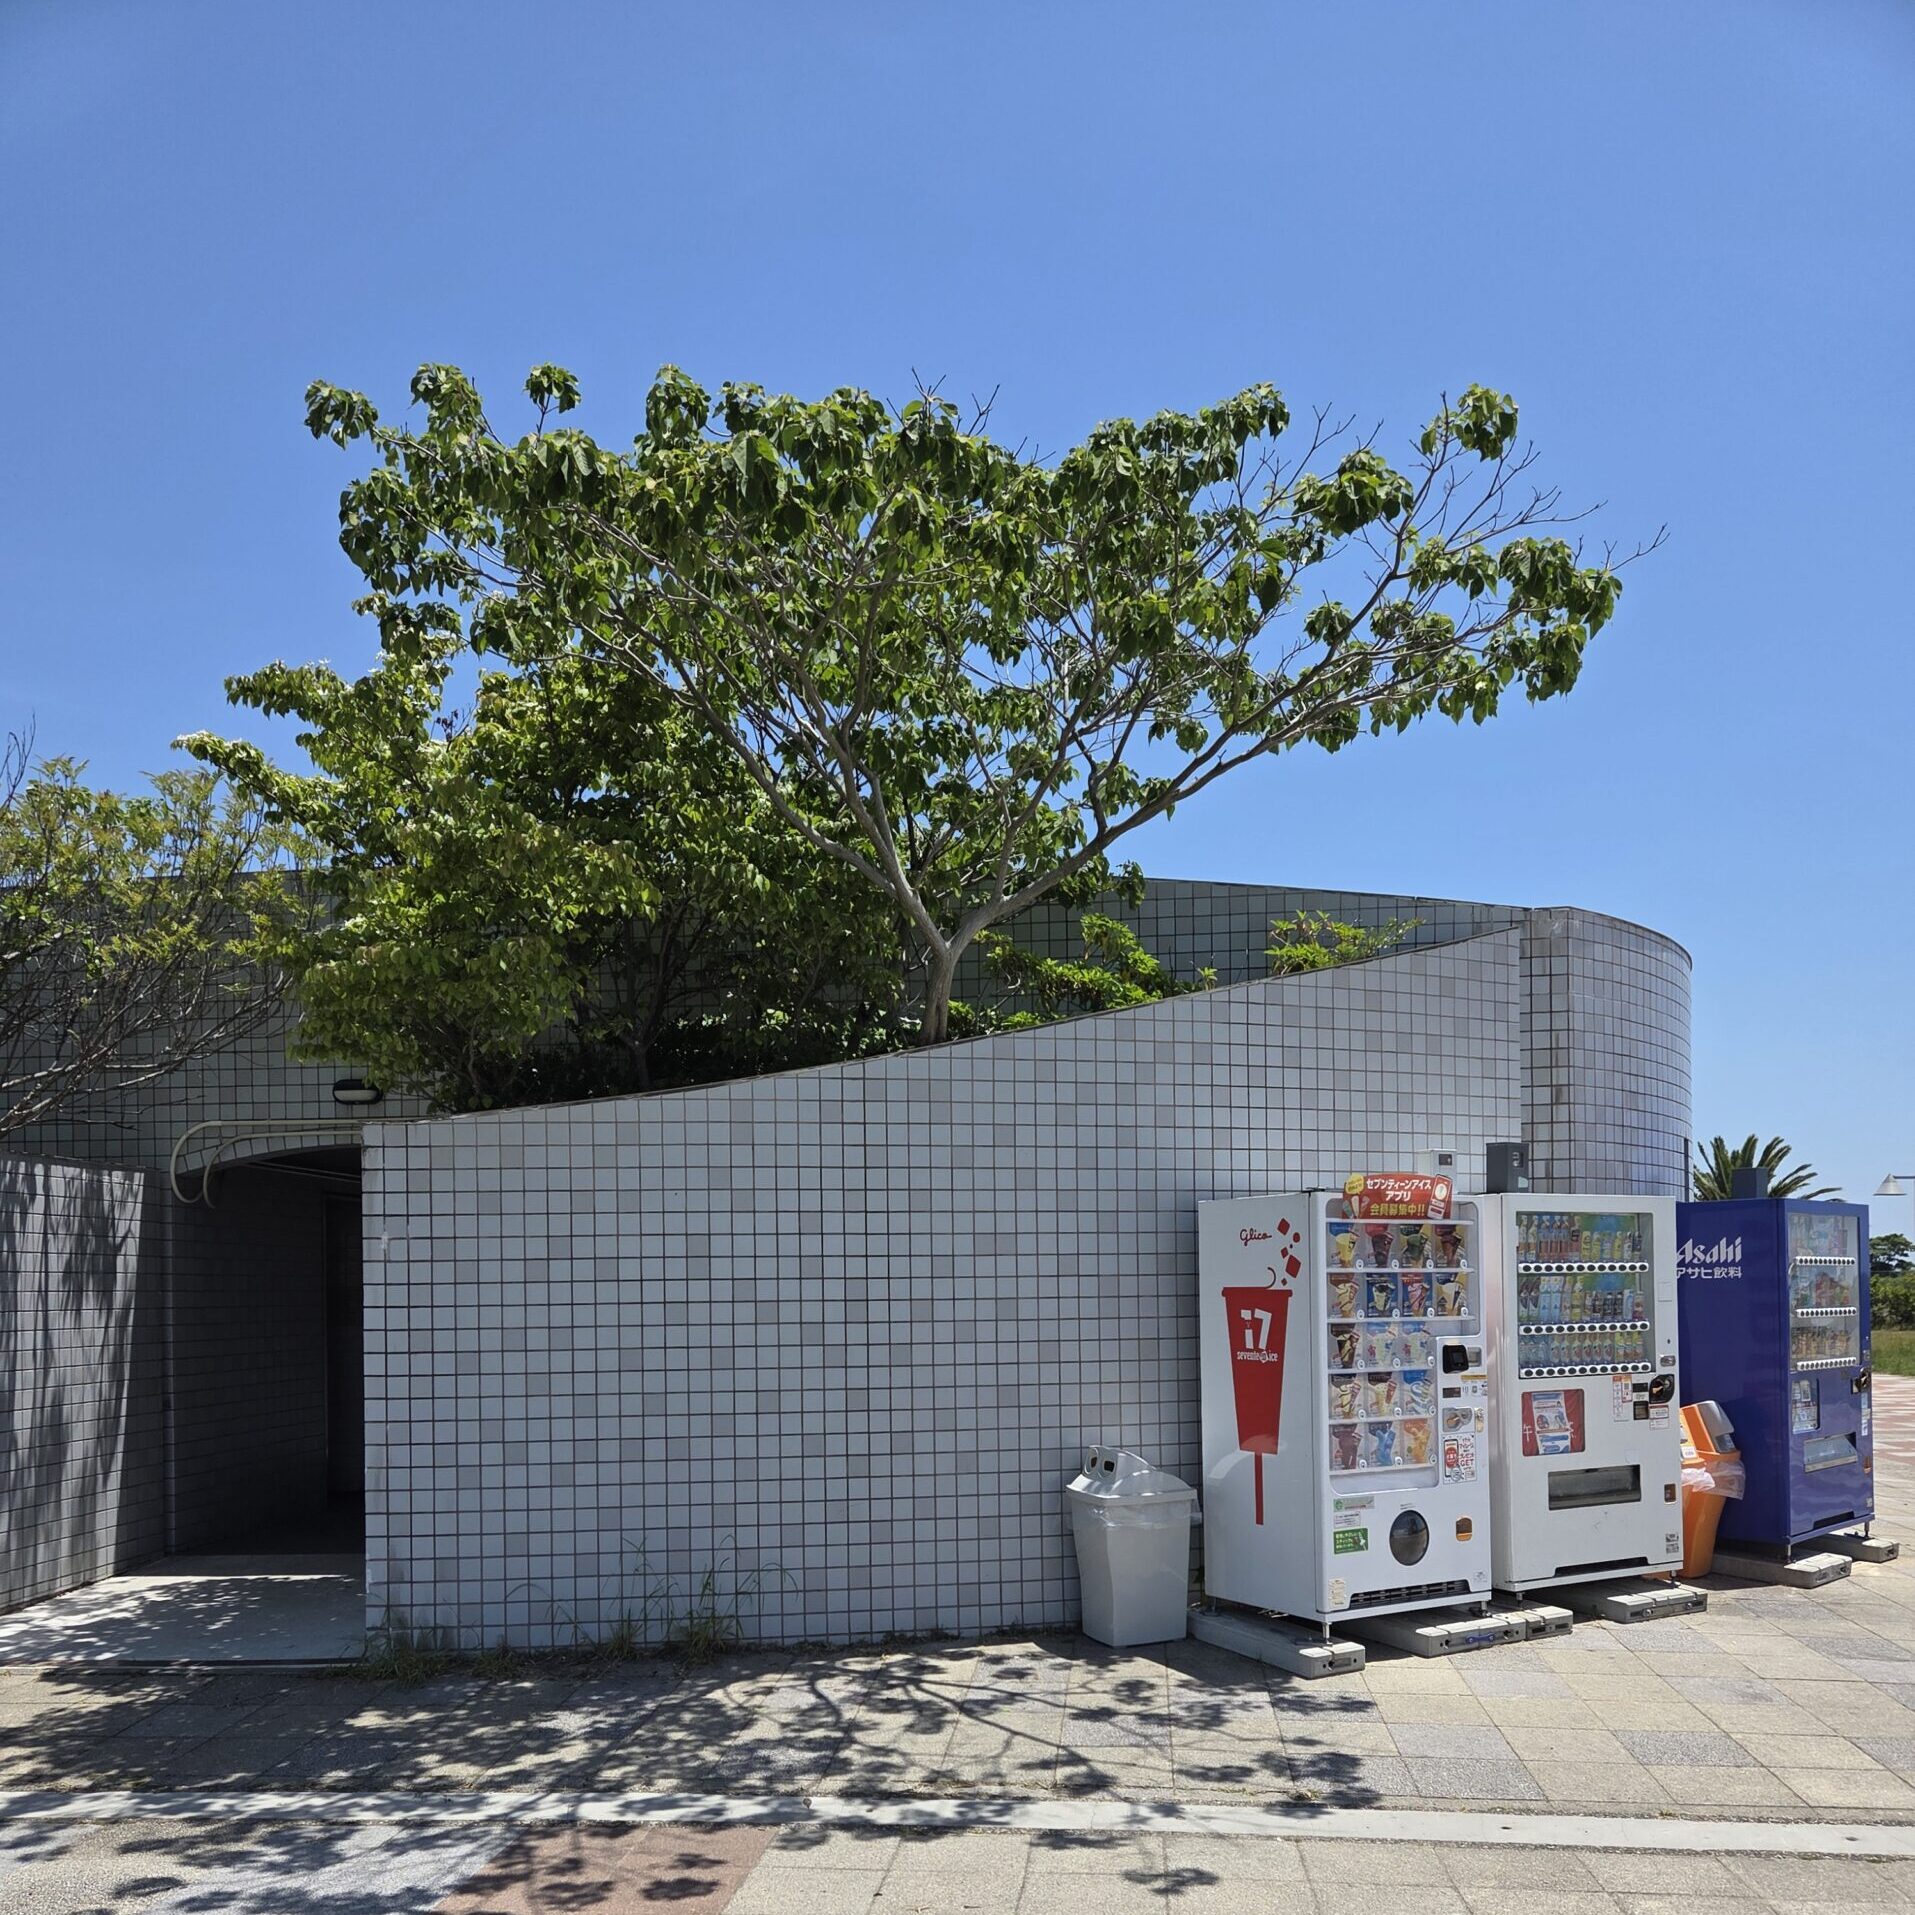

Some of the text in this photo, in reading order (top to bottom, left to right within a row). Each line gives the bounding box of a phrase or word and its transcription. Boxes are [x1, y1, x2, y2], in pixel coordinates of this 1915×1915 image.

[1366, 1179, 1431, 1190] セブンティーンアイス
[1385, 1190, 1411, 1202] アプリ
[1239, 1227, 1272, 1247] Glico
[1676, 1236, 1742, 1264] Asahi
[1676, 1266, 1742, 1279] アサヒ飲料
